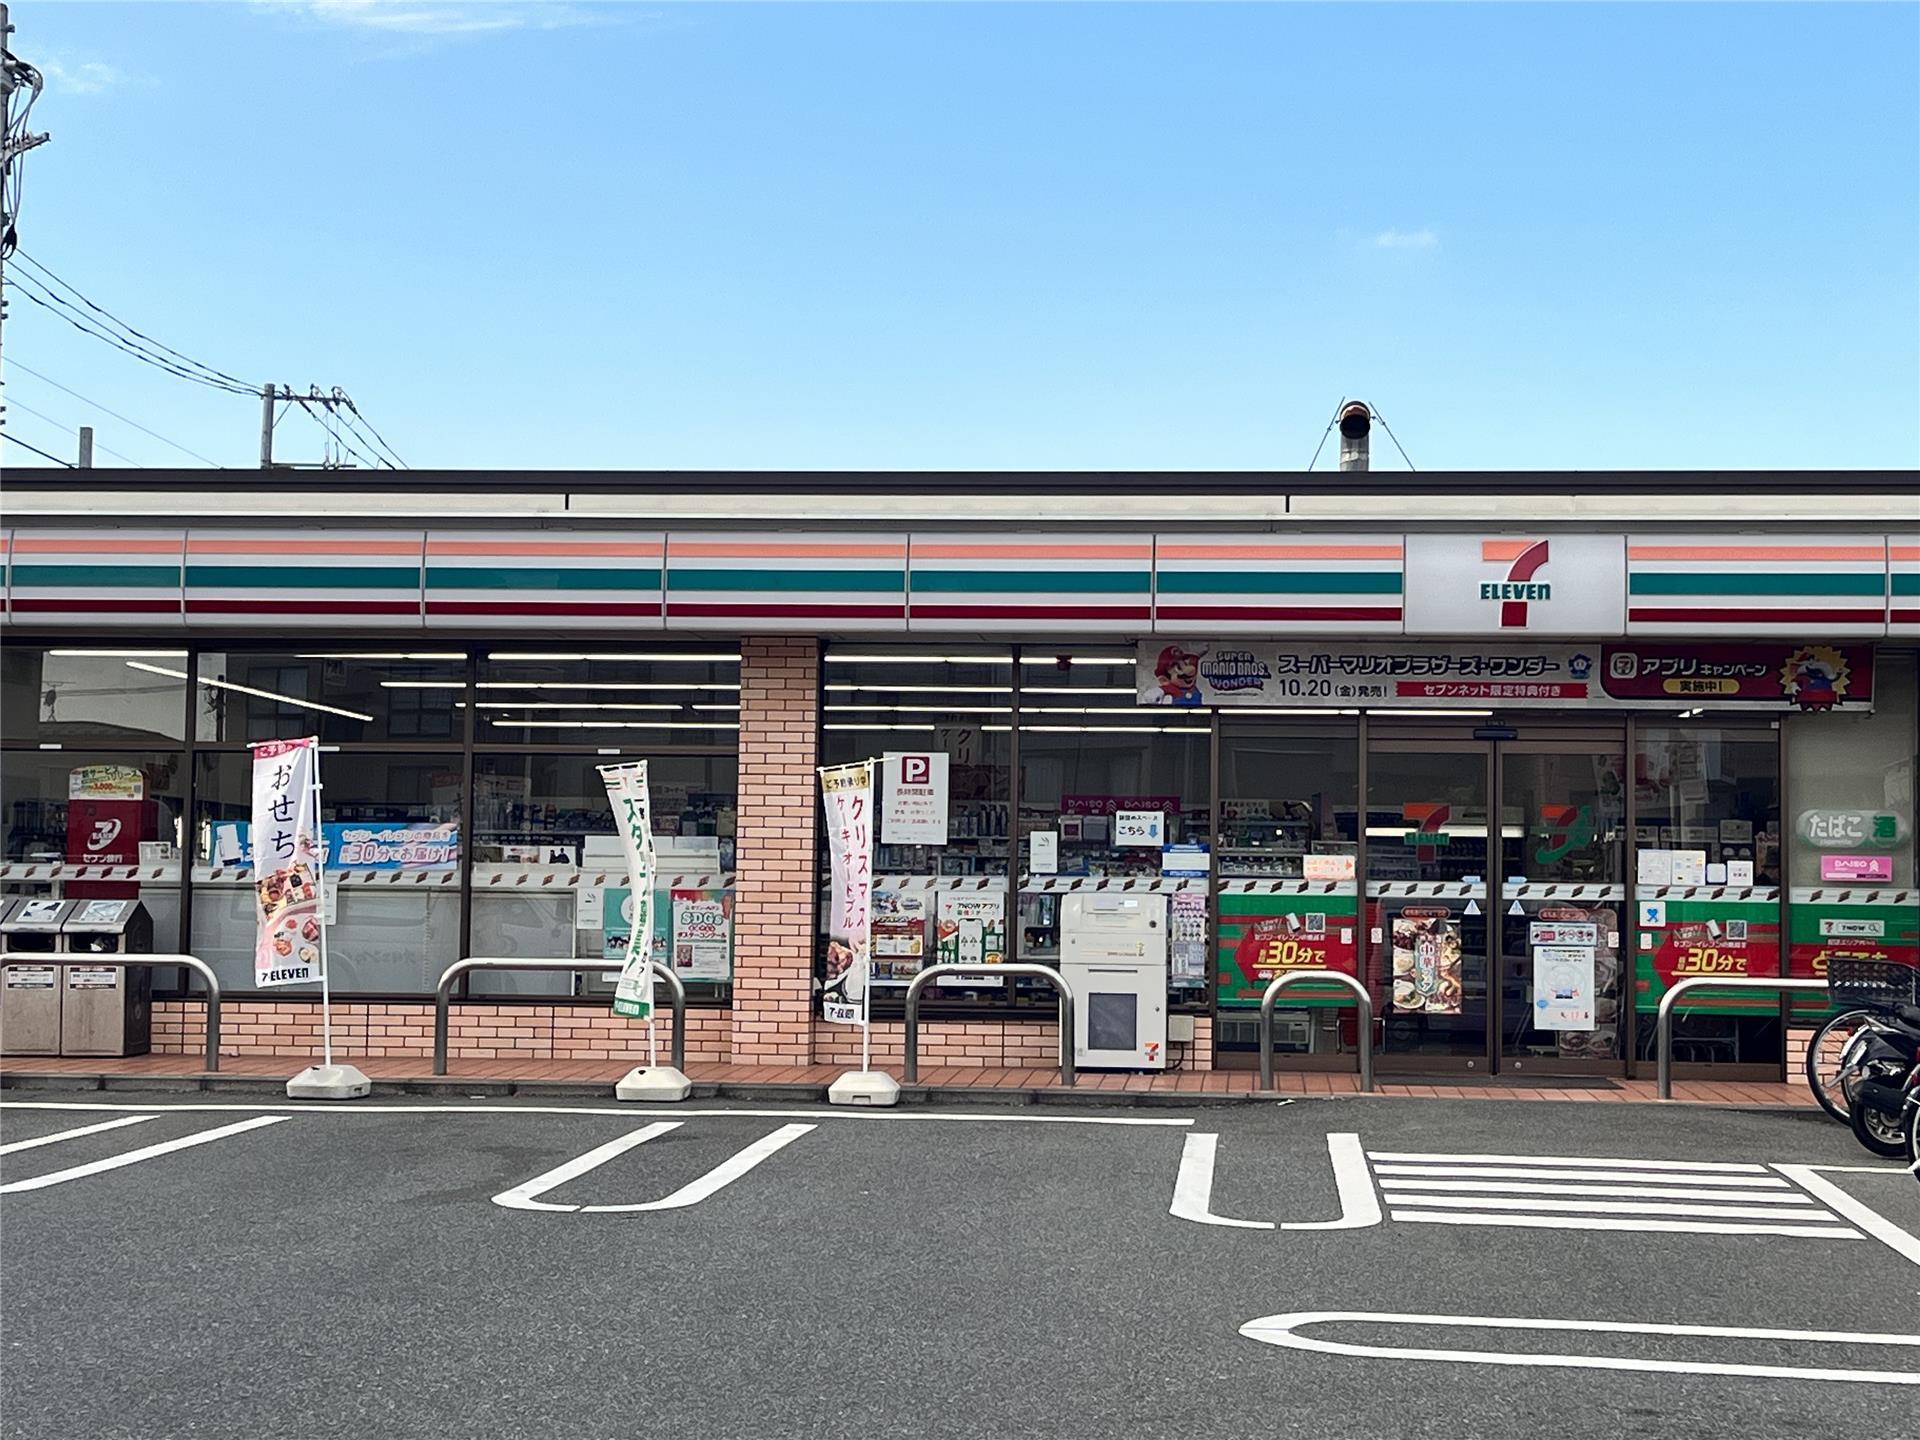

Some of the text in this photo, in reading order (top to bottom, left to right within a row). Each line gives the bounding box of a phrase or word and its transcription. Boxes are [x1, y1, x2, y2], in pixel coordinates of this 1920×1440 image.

[1217, 651, 1253, 662] SUPER
[1642, 658, 1767, 676] アプリ キャンペーン
[1210, 677, 1262, 690] WONDER
[1423, 684, 1561, 698] セブンネット限定特典付き
[1068, 800, 1103, 808] DAISO
[1124, 801, 1160, 809] DAISO
[267, 764, 295, 860] おせち
[1118, 825, 1146, 836] こちら
[1810, 814, 1897, 838] たばこ 酒
[852, 795, 868, 928] クリスマス
[1834, 860, 1867, 868] DAISO
[681, 911, 723, 926] SDGs
